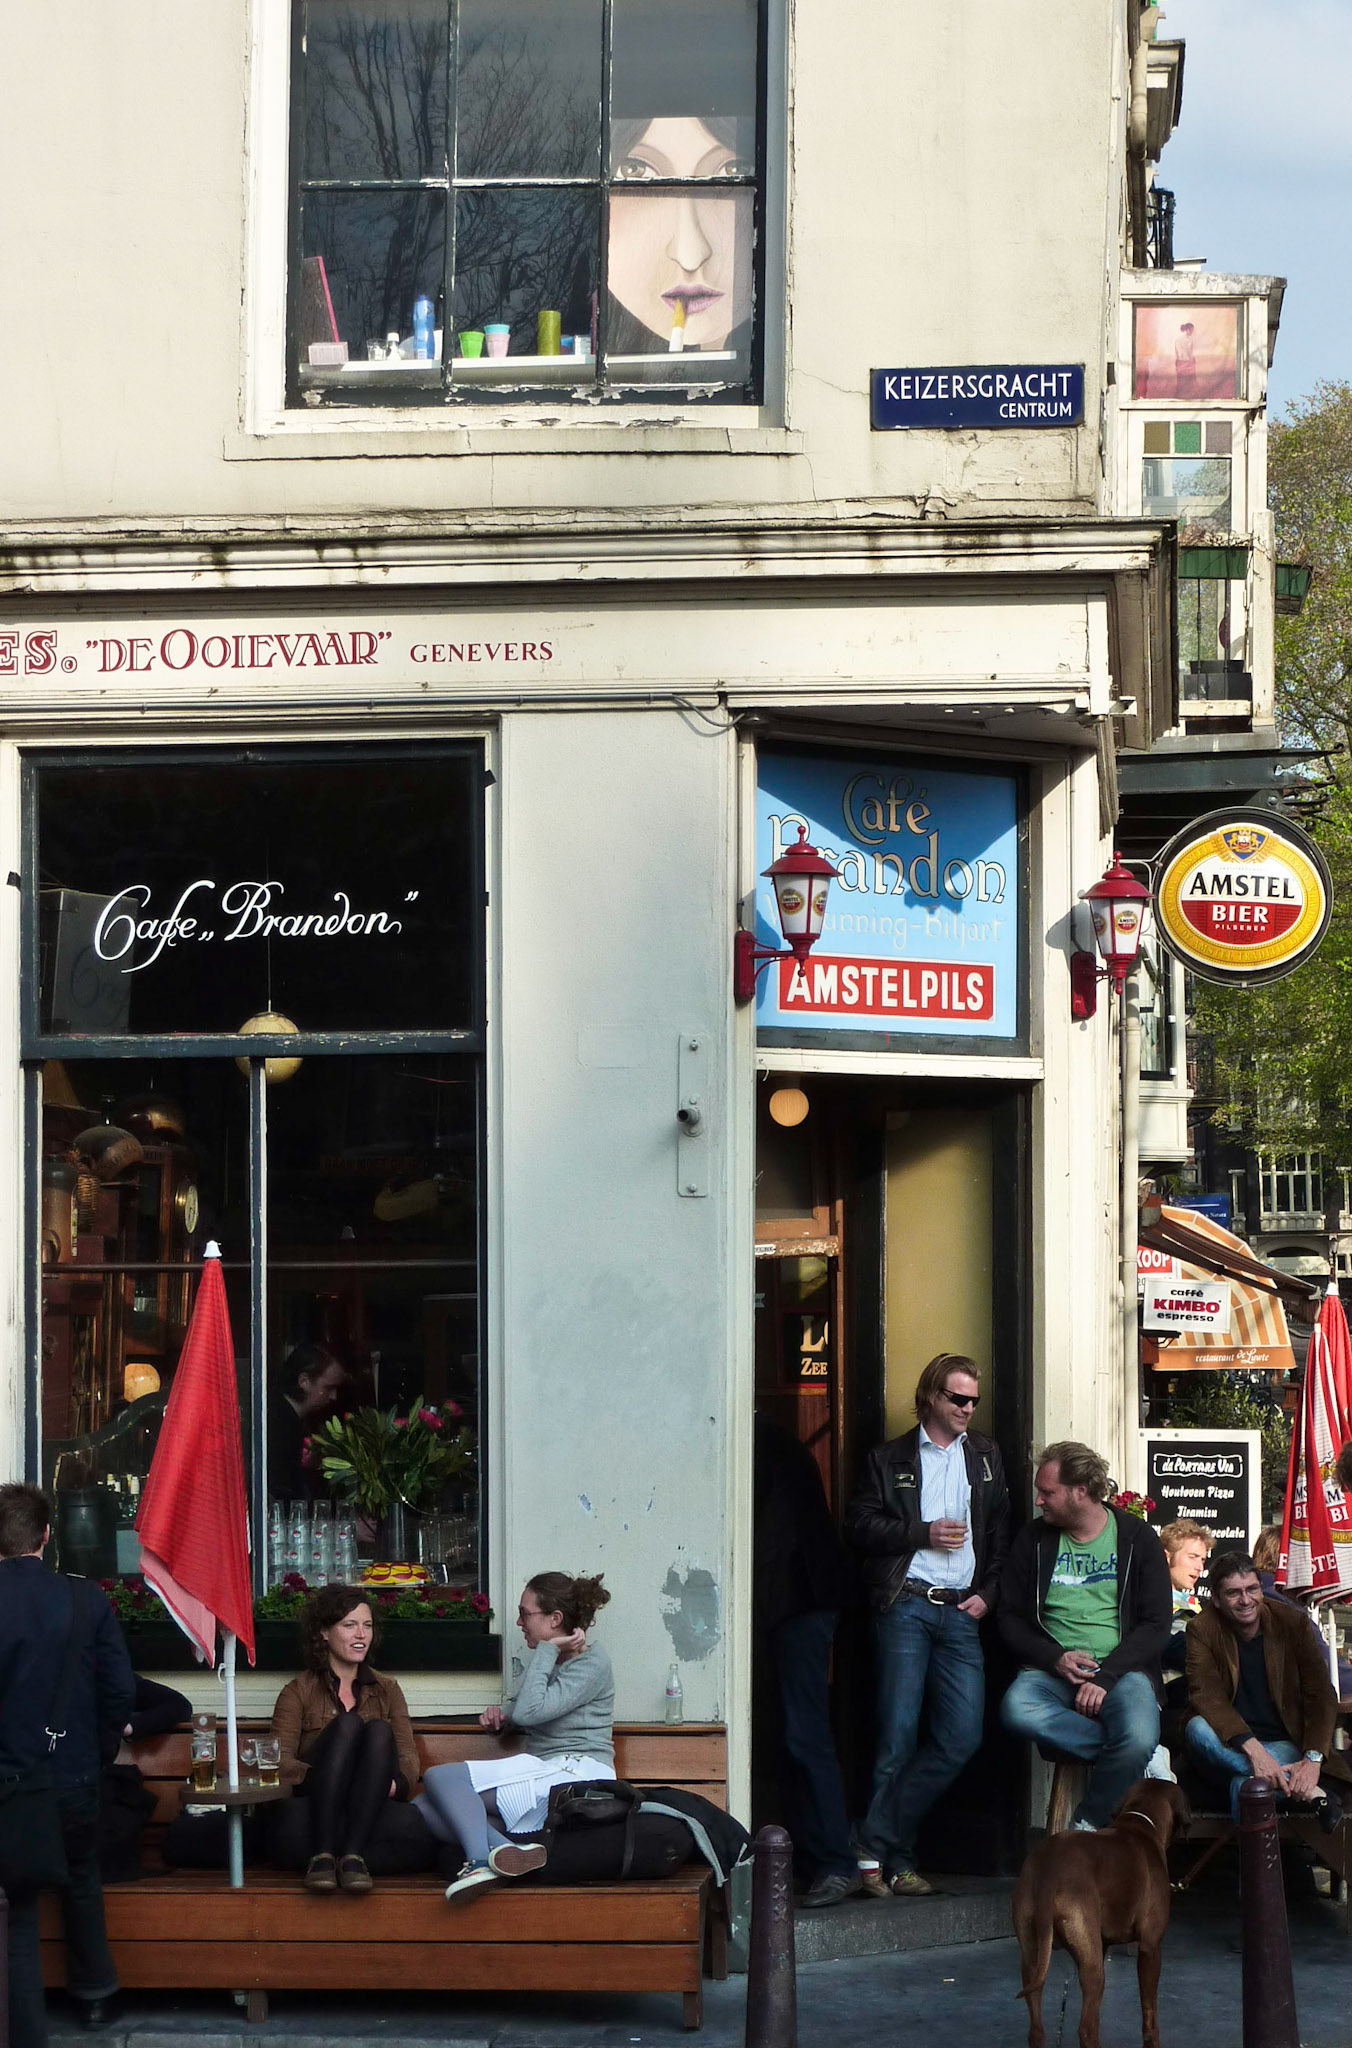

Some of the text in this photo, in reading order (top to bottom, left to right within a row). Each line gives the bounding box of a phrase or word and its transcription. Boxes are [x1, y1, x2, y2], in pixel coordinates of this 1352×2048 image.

[885, 373, 1073, 400] KEIZERSGRACHT
[999, 402, 1073, 418] CENTRUM
[410, 641, 553, 663] GENEVERS
[842, 772, 933, 846] Café
[1189, 872, 1295, 899] AMSTEL
[1212, 904, 1269, 924] BIER
[1215, 923, 1266, 932] PILSENER
[786, 961, 985, 1012] AMSTELPILS
[1153, 1299, 1220, 1313] KIMBO
[1157, 1312, 1214, 1322] espresso
[1195, 1354, 1235, 1363] restaurant
[1161, 1485, 1235, 1499] Houtoven Pizza
[1177, 1505, 1218, 1518] Tiramisu
